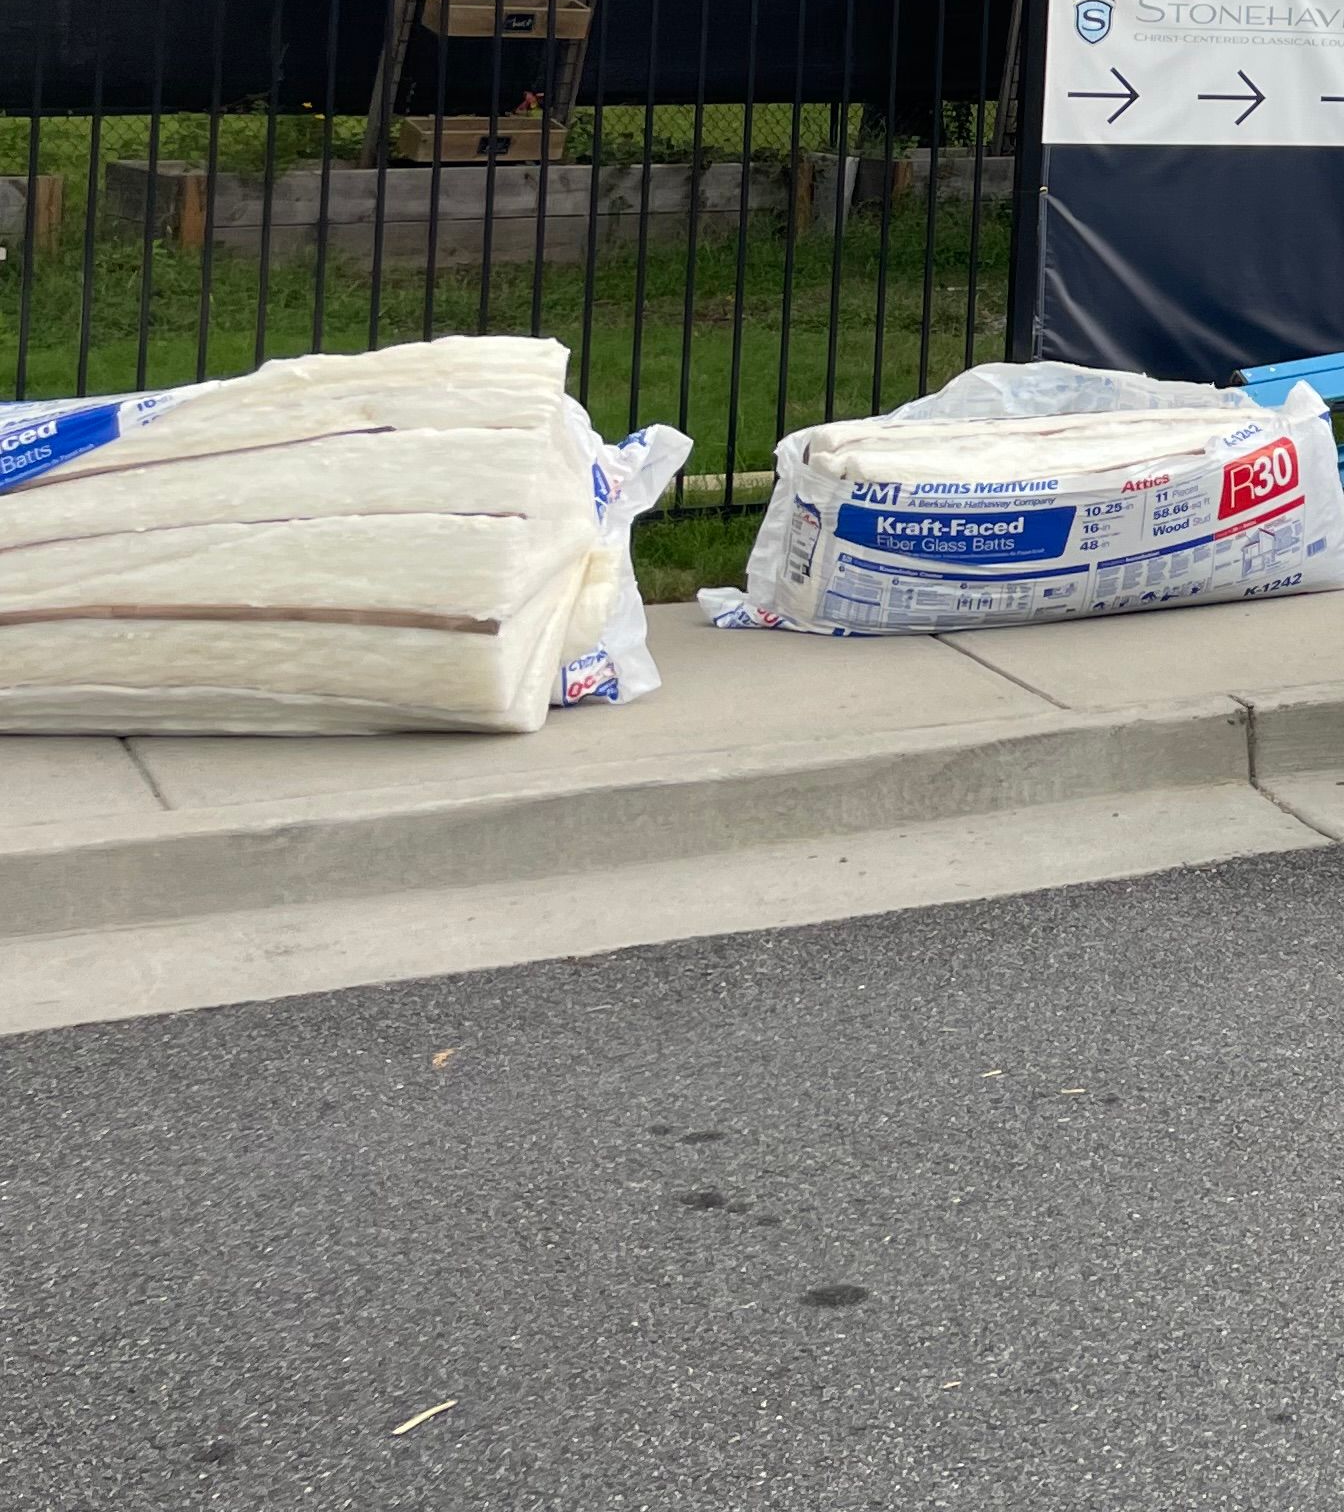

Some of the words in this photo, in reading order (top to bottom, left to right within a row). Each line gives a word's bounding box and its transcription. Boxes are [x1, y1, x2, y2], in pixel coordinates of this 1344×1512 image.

[1133, 32, 1250, 47] CHRIST-CENTERED
[1251, 34, 1319, 49] CLASSICAL
[1, 443, 54, 476] Batts
[1121, 472, 1171, 495] Attics
[1230, 446, 1294, 510] R30
[908, 499, 917, 508] A
[918, 499, 963, 509] Berkshire
[963, 500, 1011, 510] Hathaway
[1012, 496, 1056, 509] Company
[1154, 491, 1169, 504] 11
[876, 515, 1025, 538] Kraft-Faced
[1151, 518, 1190, 537] Wood
[876, 533, 917, 551] Fiber
[921, 536, 967, 553] Glass
[972, 536, 1016, 553] Batts
[1244, 571, 1304, 597] K-1242
